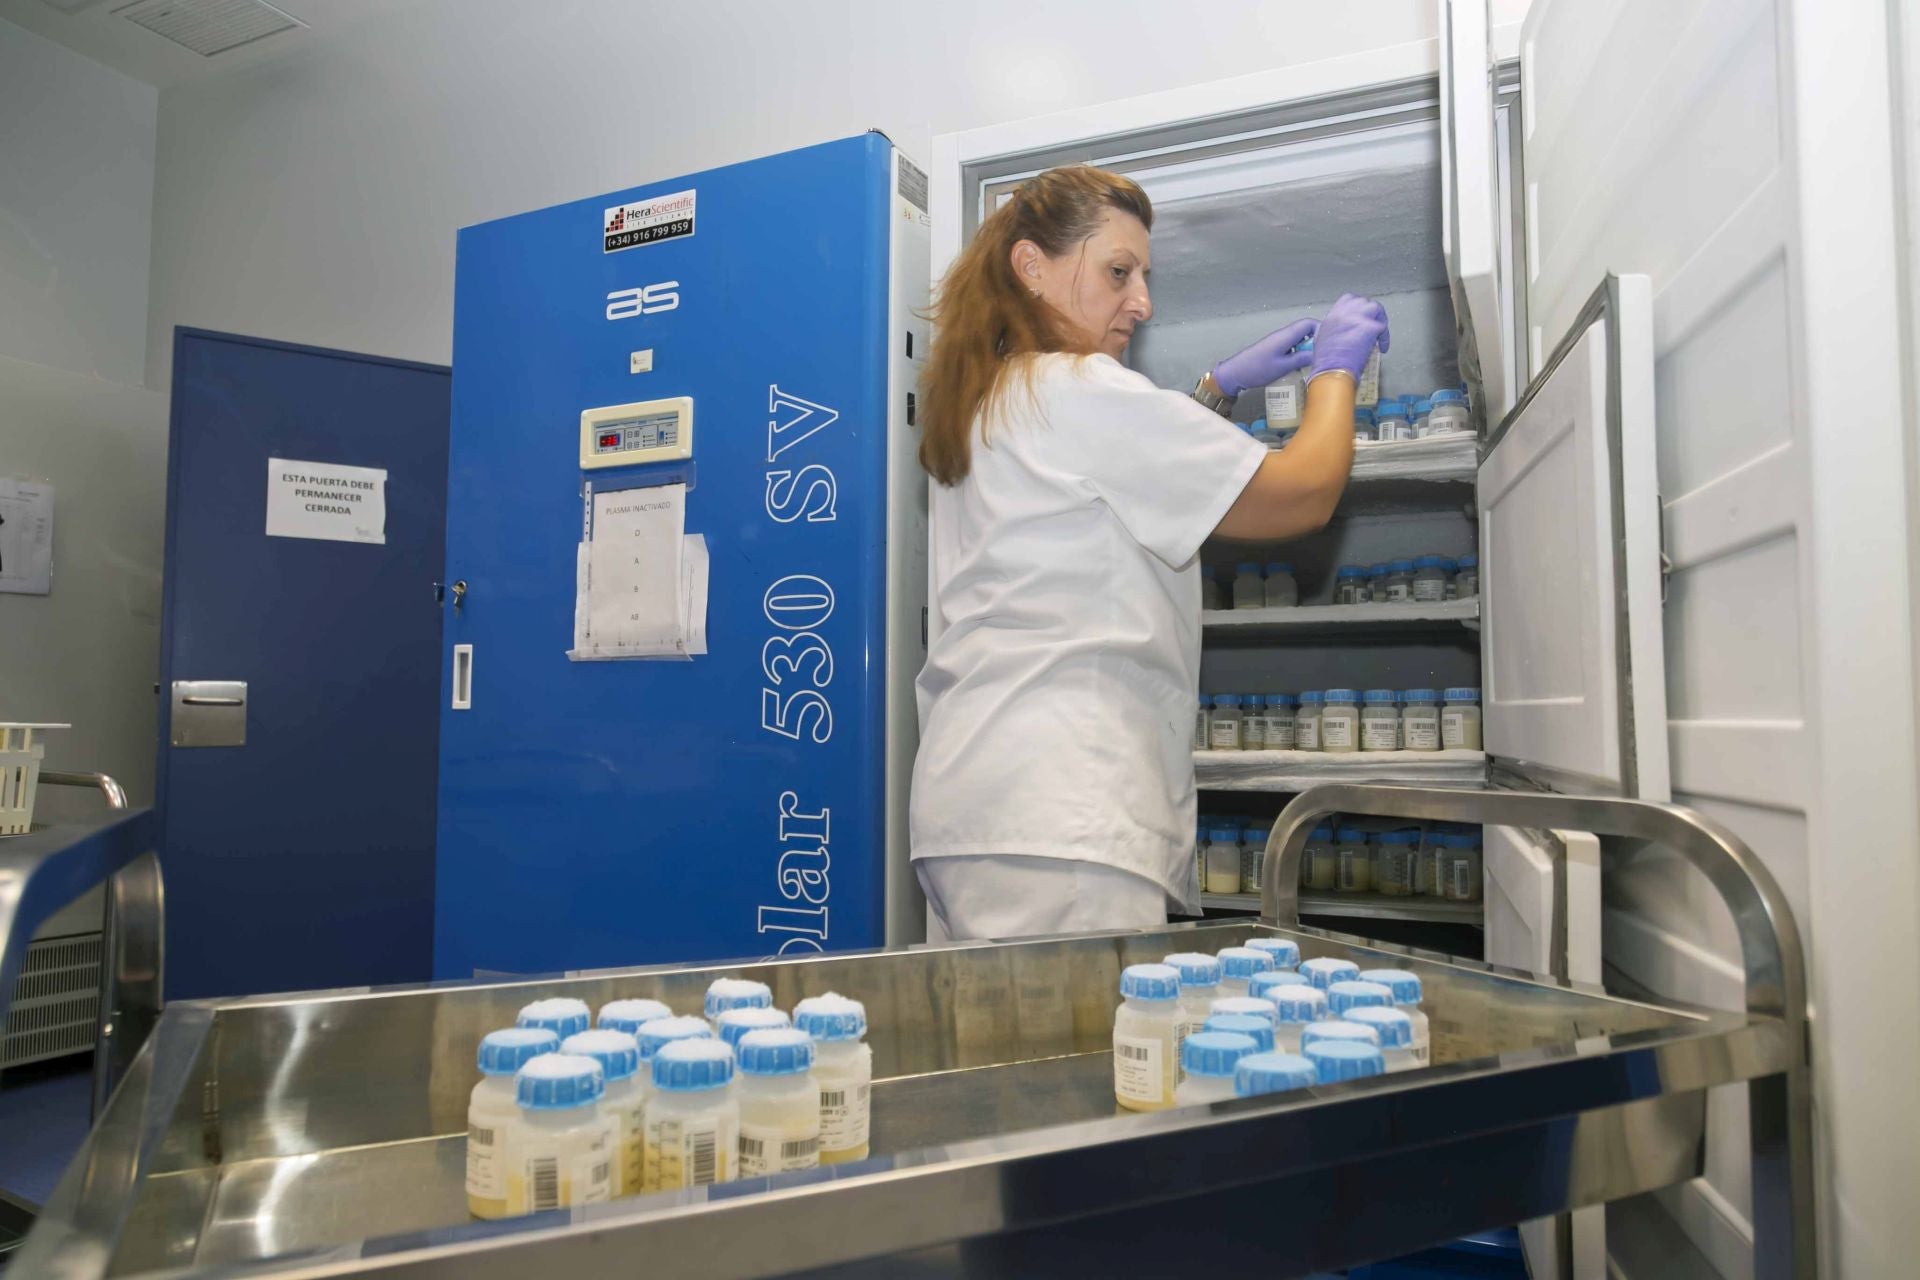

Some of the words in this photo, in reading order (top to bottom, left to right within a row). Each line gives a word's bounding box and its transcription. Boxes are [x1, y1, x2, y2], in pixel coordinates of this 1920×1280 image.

[627, 197, 694, 220] HeraScientific
[607, 234, 631, 247] (+34)
[633, 230, 650, 242] 916
[652, 225, 669, 238] 799
[671, 221, 689, 234] 959
[765, 384, 839, 523] SV
[282, 474, 306, 484] ESTA
[309, 476, 348, 488] PUERTA
[350, 480, 375, 490] DEBE
[295, 489, 362, 502] PERMANECER
[305, 503, 351, 515] CERRADA
[606, 506, 631, 515] PLASMA
[632, 501, 671, 512] INACTIVADO
[630, 613, 639, 621] AB
[762, 574, 835, 743] 530
